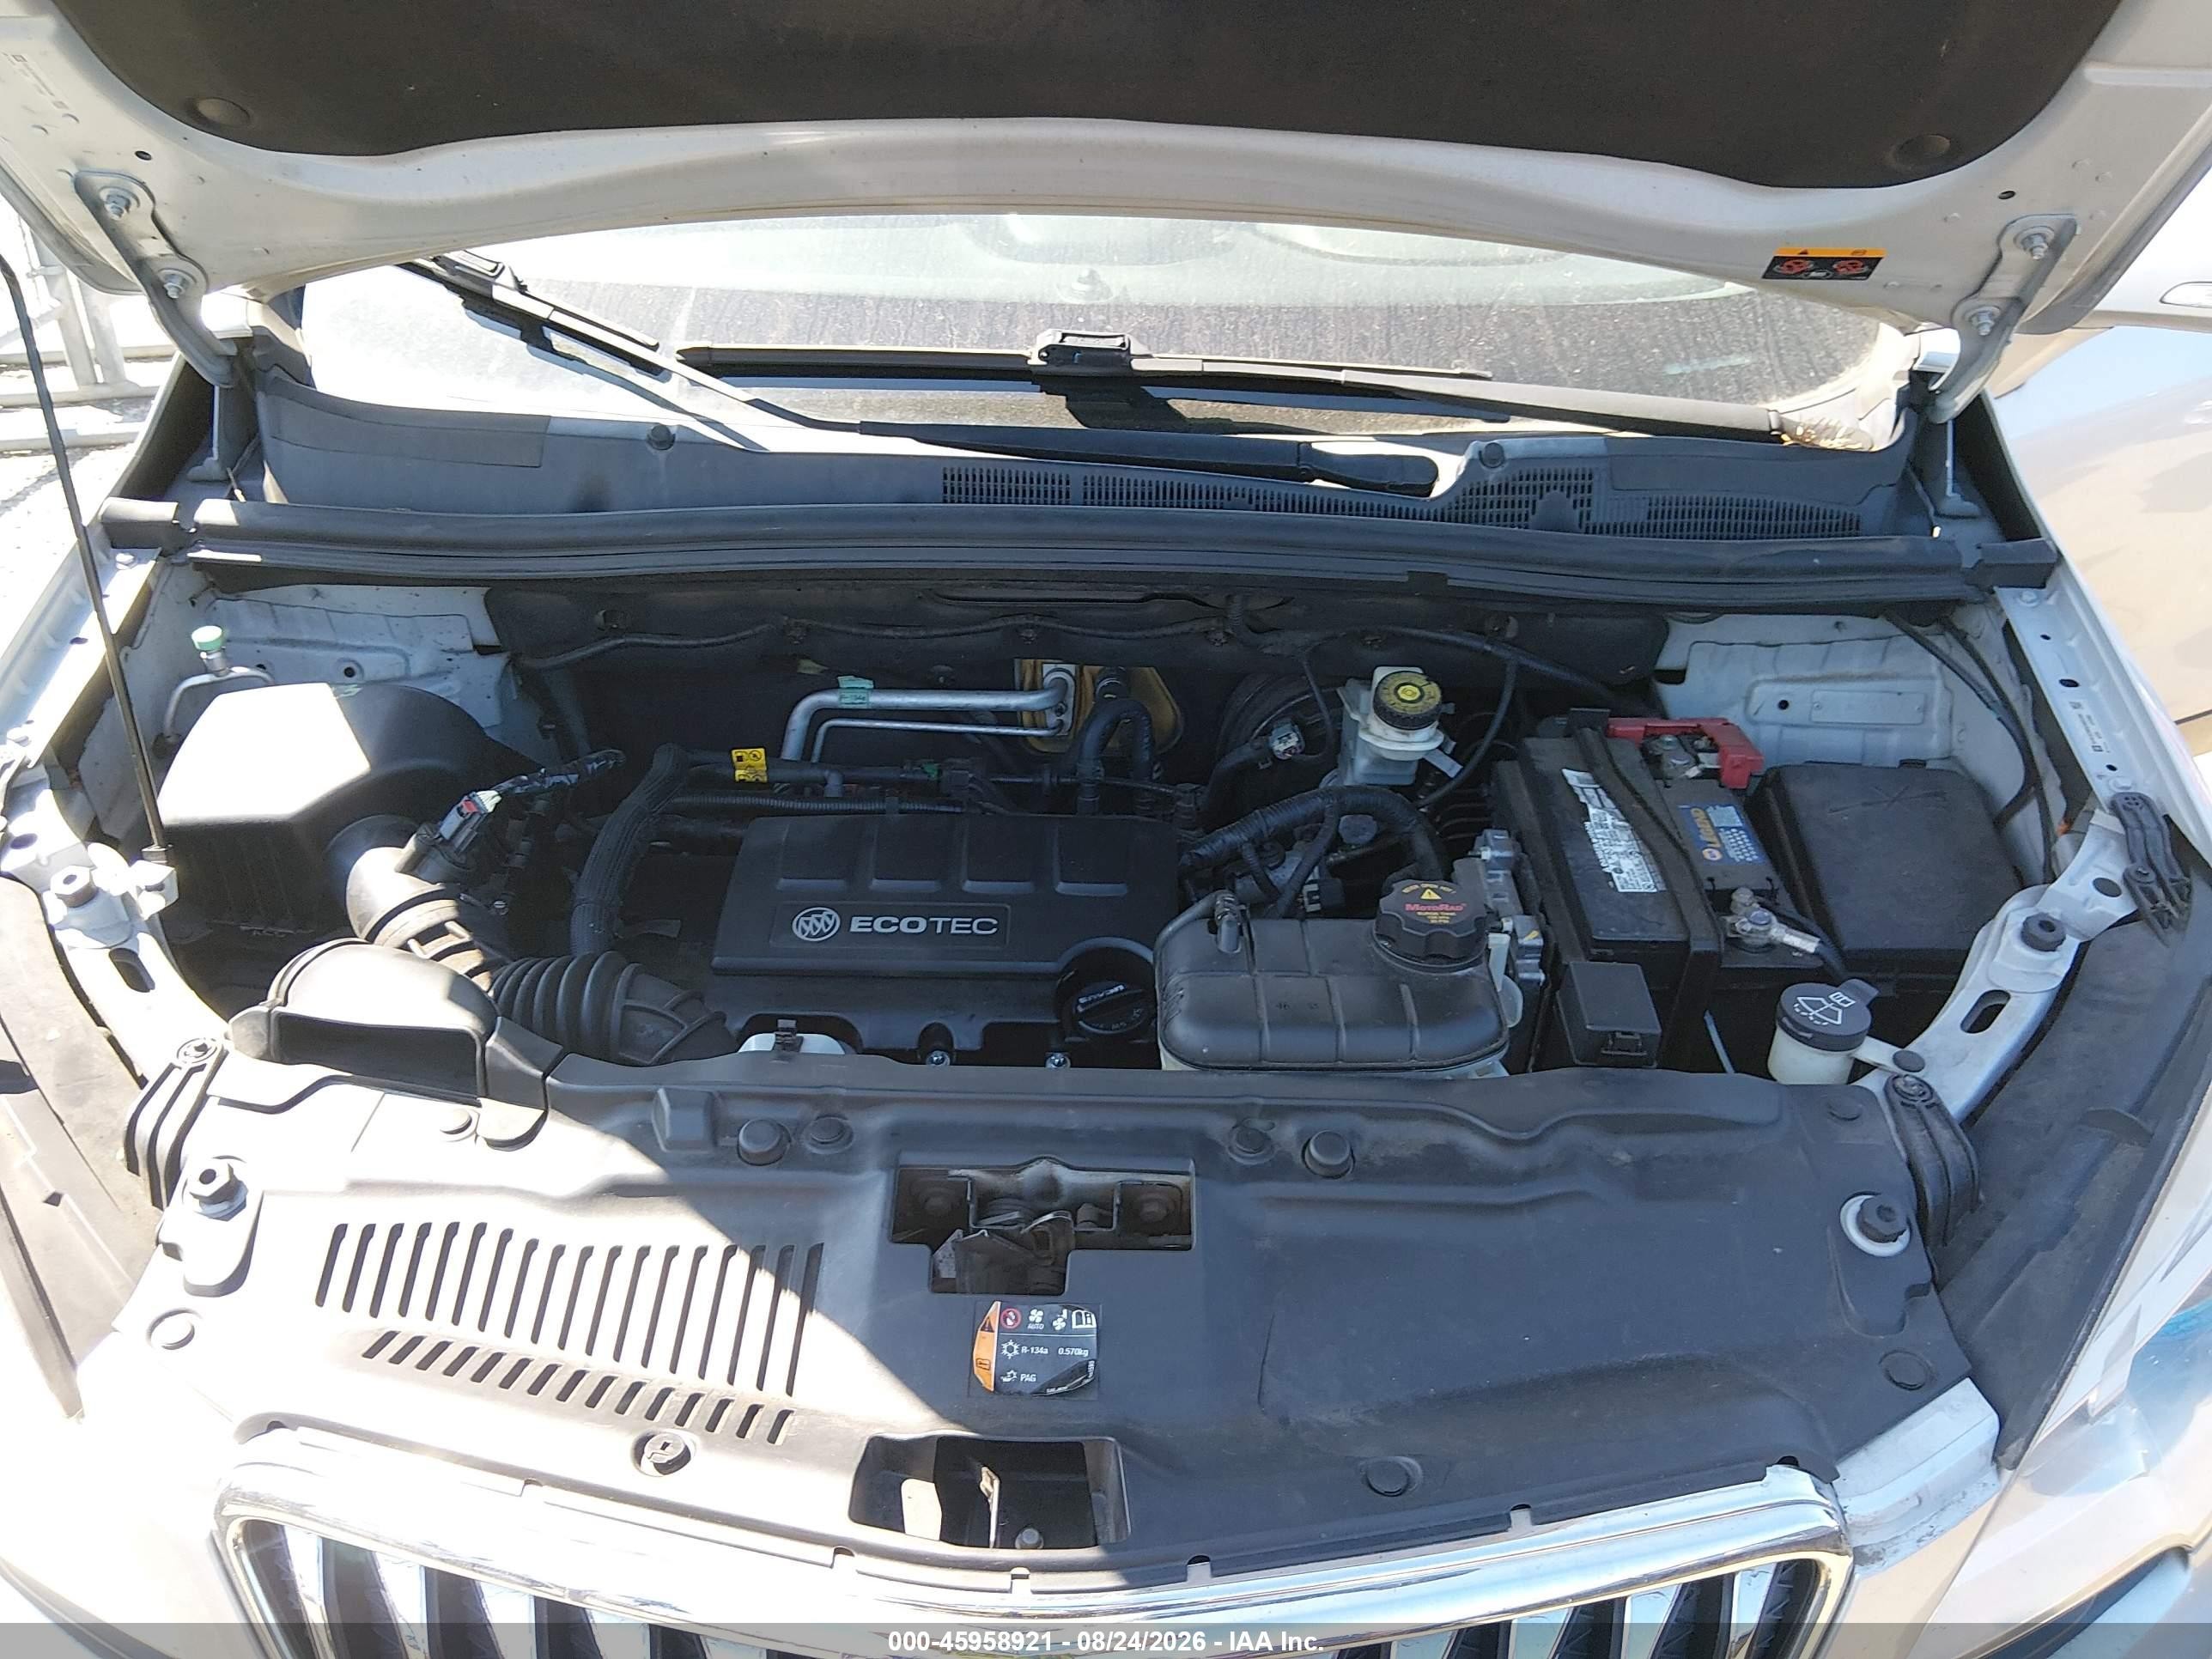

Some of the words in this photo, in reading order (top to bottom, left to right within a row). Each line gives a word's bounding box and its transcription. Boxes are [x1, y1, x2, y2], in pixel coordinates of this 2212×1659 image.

[849, 916, 998, 934] ECOTEC
[1058, 1347, 1090, 1358] 0.570kg
[1020, 1373, 1037, 1382] PAG
